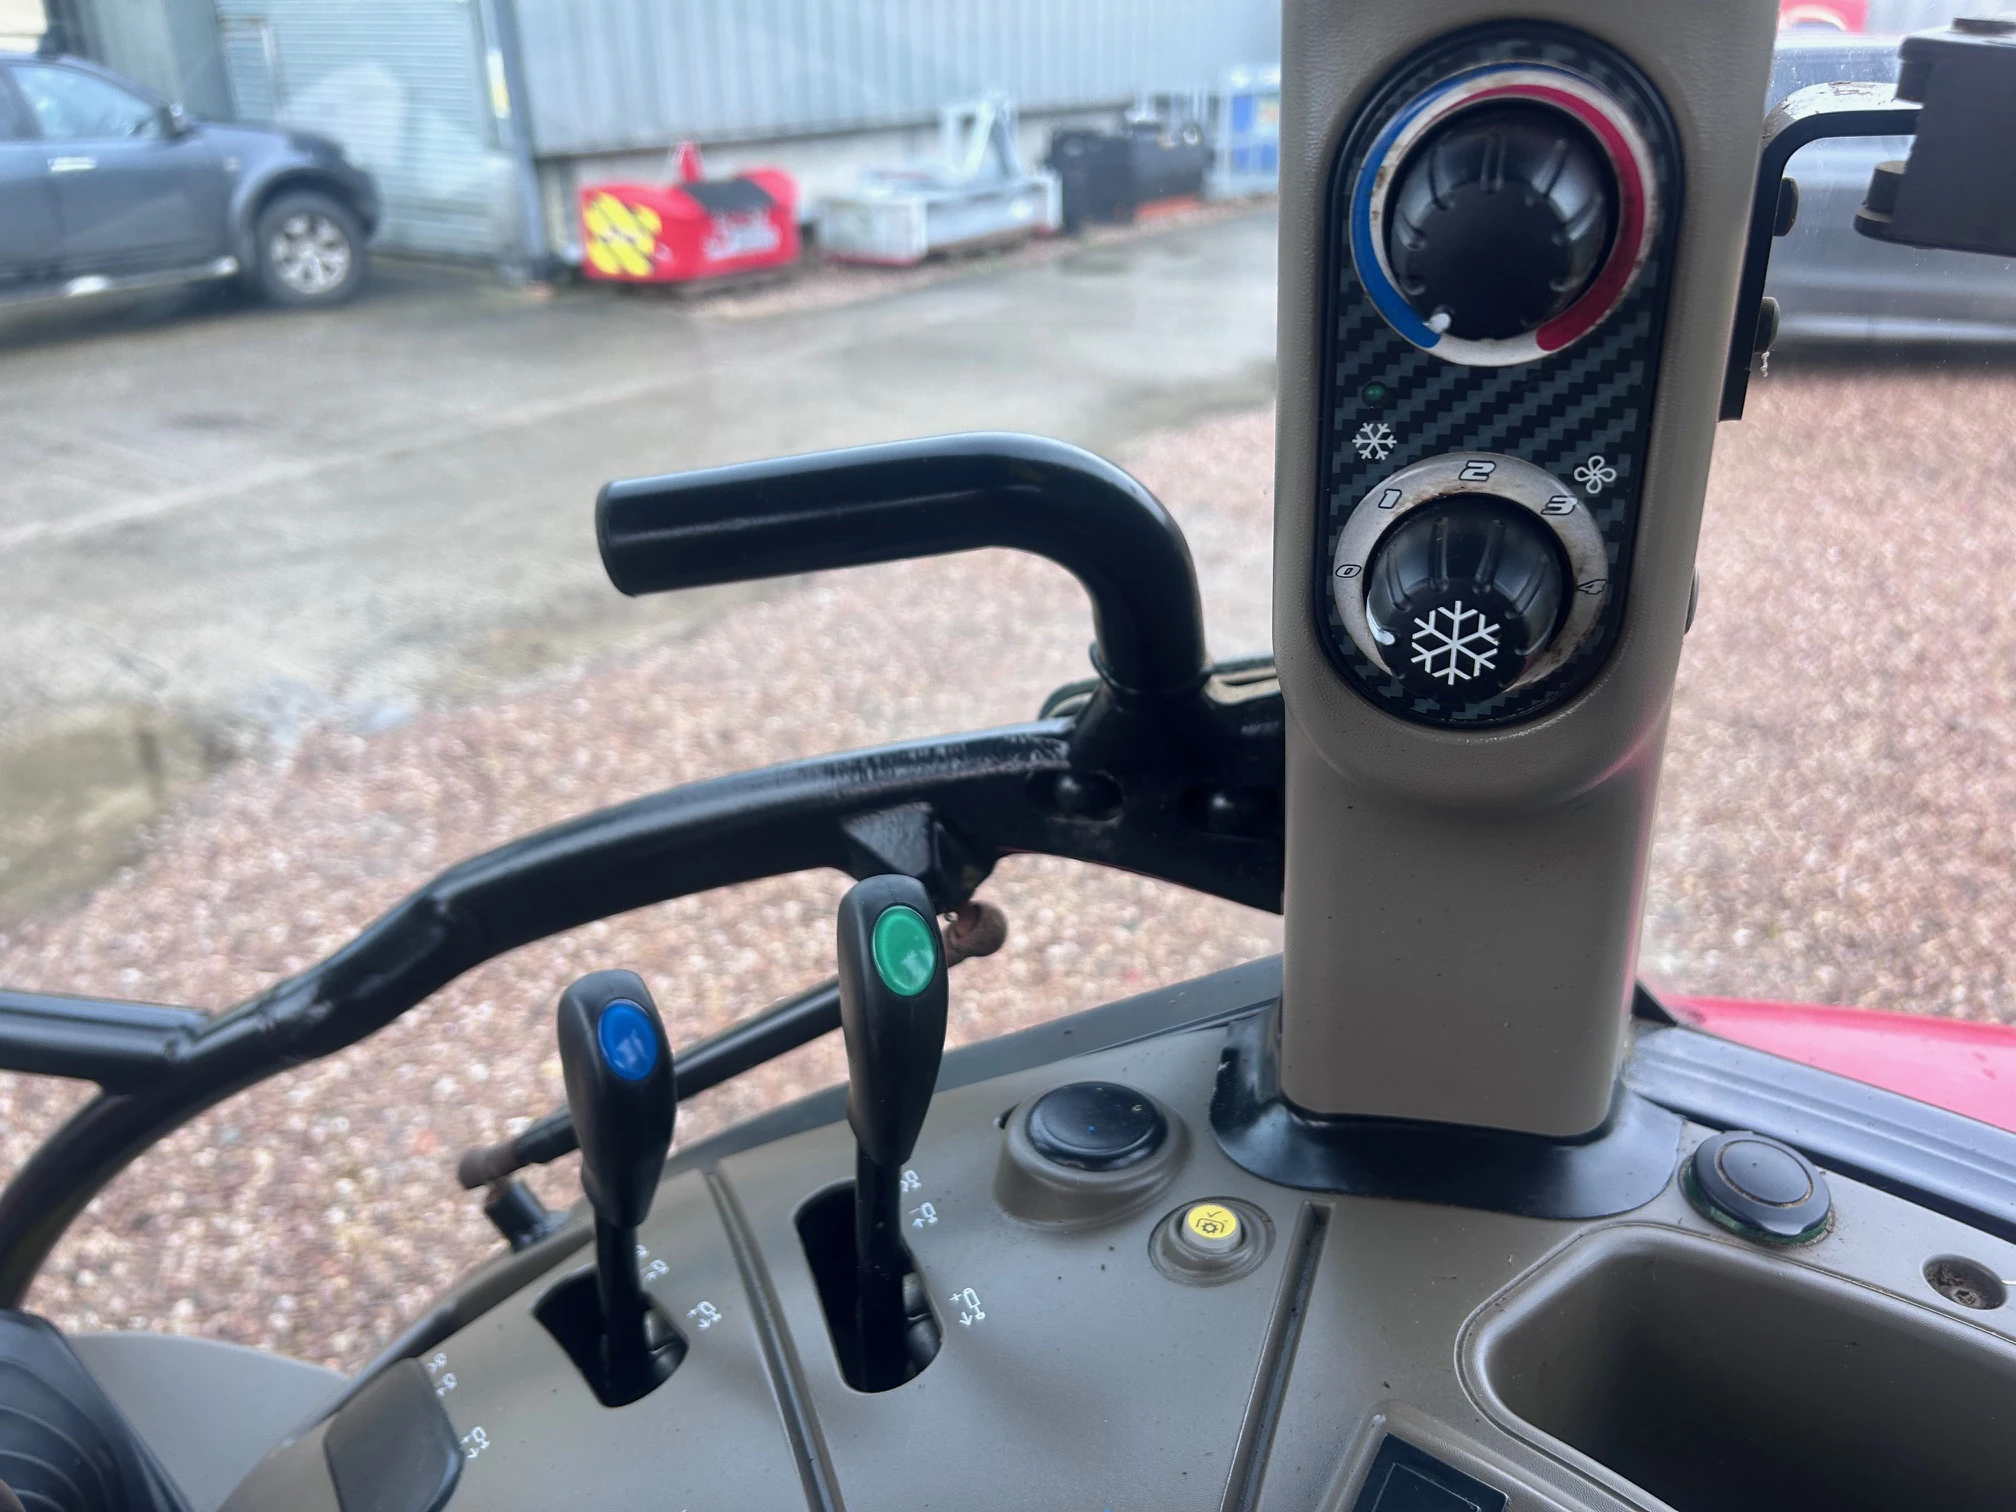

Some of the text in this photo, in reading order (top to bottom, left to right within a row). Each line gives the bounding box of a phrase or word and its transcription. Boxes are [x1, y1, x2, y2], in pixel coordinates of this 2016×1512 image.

[1458, 460, 1496, 482] 2
[1377, 488, 1402, 510] 1
[1541, 495, 1578, 516] 3
[1335, 564, 1362, 578] 0
[1576, 579, 1607, 595] 4
